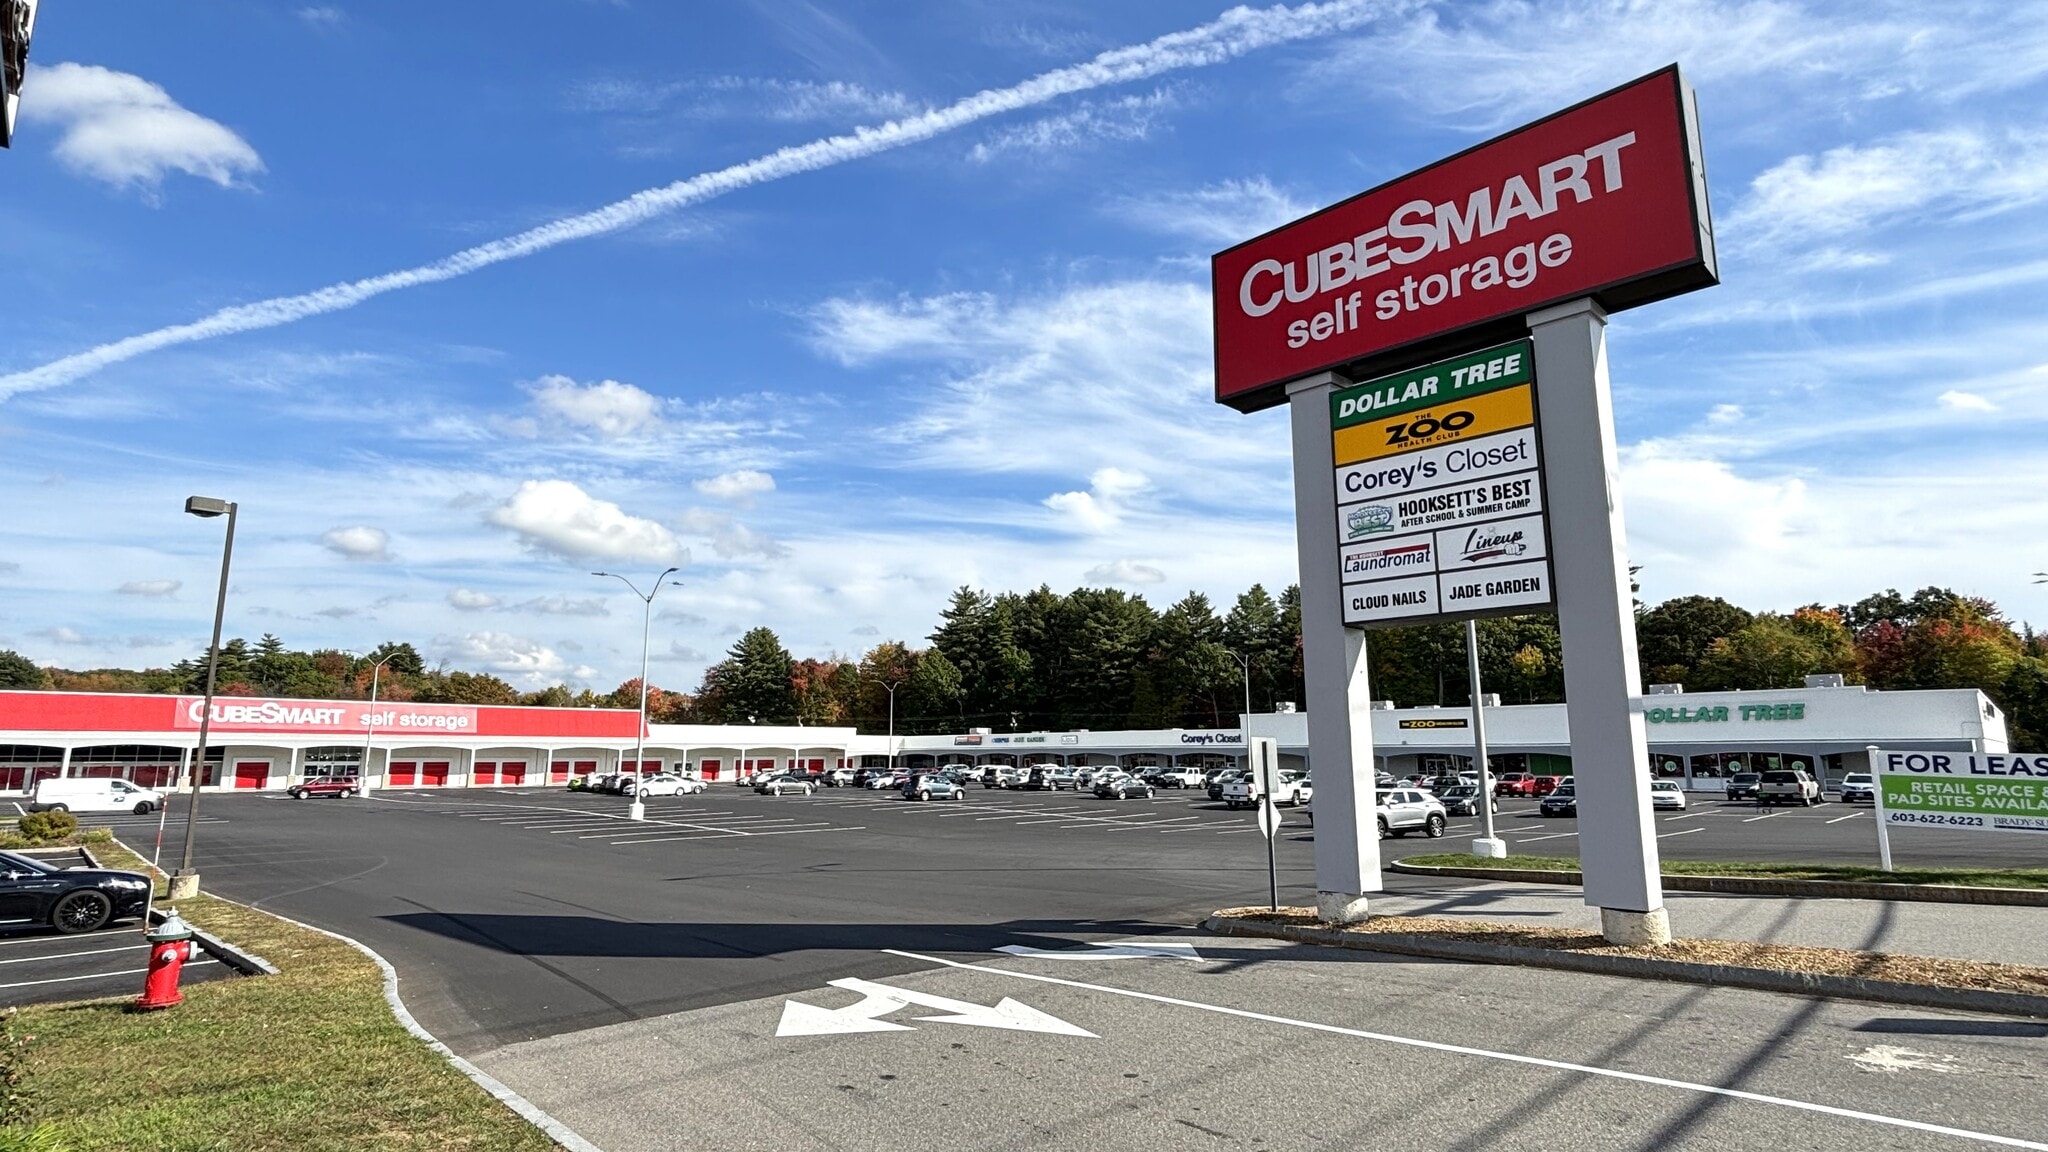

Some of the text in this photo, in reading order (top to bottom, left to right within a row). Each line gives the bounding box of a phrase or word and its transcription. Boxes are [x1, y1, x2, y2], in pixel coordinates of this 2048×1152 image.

[1287, 232, 1573, 349] self storage
[1339, 353, 1522, 418] DOLLAR TREE
[1415, 412, 1432, 421] THE
[1385, 411, 1475, 445] ZOO
[1397, 431, 1460, 449] HEALTH CLUB
[1345, 437, 1528, 493] Corey's Closet
[1398, 478, 1532, 518] HOOKSETT'S BEST
[1400, 497, 1531, 528] AFTER SCHOOL & SUMMER CAMP
[1461, 528, 1523, 555] Lineup
[1344, 547, 1431, 573] Laundromat
[1449, 577, 1541, 600] JADE GARDEN
[1352, 590, 1427, 610] CLOUD NAILS
[360, 709, 394, 726] self
[399, 710, 468, 730] storage
[1643, 703, 1805, 723] OLLAR TREE
[1410, 720, 1436, 728] ZOO
[1181, 733, 1242, 745] Corey's Closet
[1887, 754, 1953, 773] FOR
[1911, 781, 1971, 795] RETAIL
[1975, 784, 2036, 797] SPACE
[1888, 793, 1923, 805] PAD
[1928, 794, 1976, 807] SITES
[1891, 812, 1984, 826] 603-622-6223
